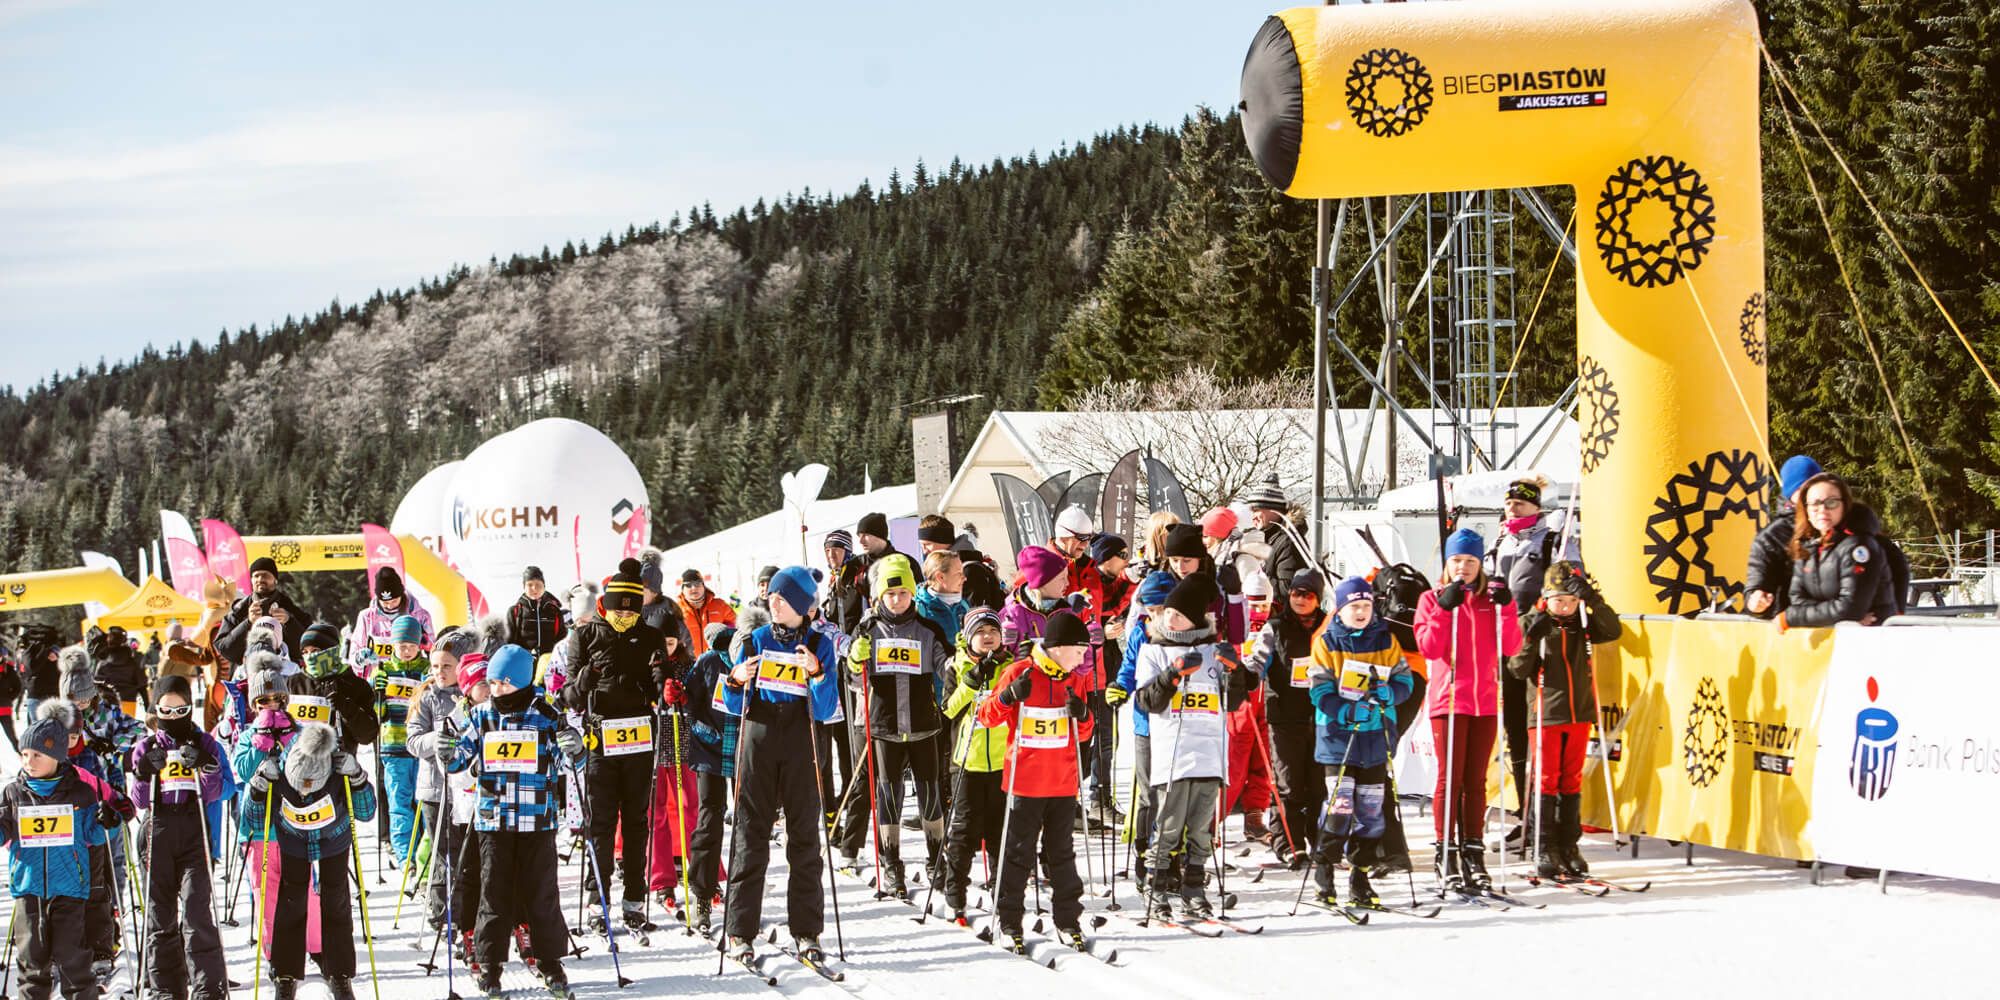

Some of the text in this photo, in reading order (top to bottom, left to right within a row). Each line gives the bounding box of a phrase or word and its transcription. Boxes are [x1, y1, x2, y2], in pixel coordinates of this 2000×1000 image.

[1443, 67, 1606, 95] BIEGPIASTÓW
[1516, 94, 1590, 108] JAKUSZYCE
[475, 505, 559, 529] KGHM
[376, 644, 393, 655] 78
[888, 647, 910, 661] 46
[775, 663, 799, 681] 71
[1357, 673, 1368, 688] 7
[396, 684, 413, 697] 75
[1185, 693, 1208, 708] 62
[297, 705, 318, 719] 88
[1034, 719, 1057, 735] 51
[616, 727, 638, 743] 31
[496, 742, 522, 758] 47
[295, 811, 320, 823] 80
[33, 817, 58, 833] 37
